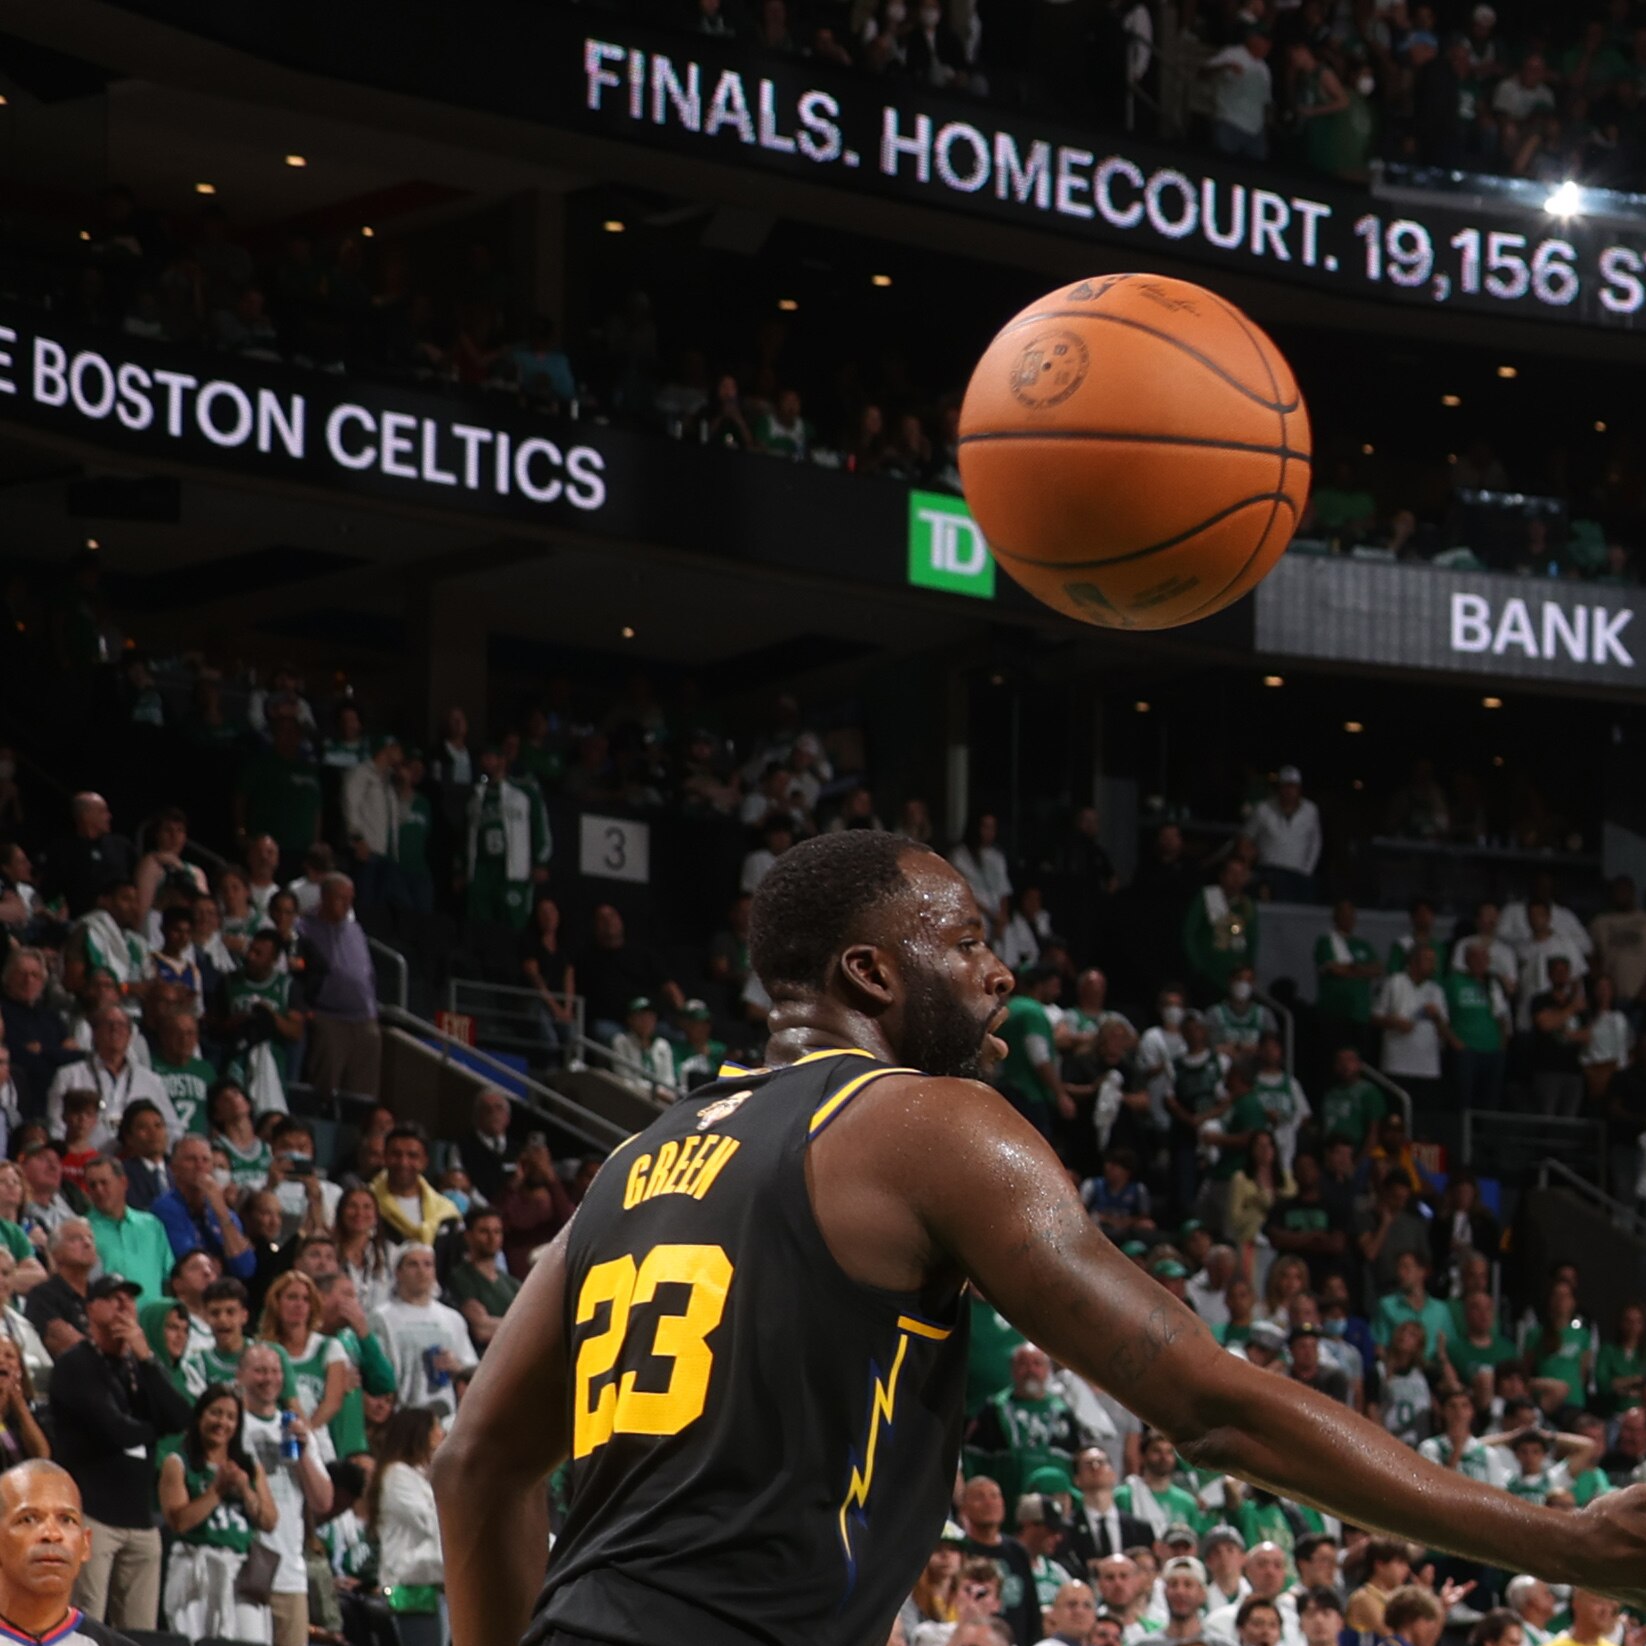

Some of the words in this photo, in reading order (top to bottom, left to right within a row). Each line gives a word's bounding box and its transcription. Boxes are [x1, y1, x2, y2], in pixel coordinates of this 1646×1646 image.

[585, 39, 860, 166] FINALS.
[881, 107, 1338, 271] HOMECOURT.
[1356, 212, 1578, 303] 19,156
[33, 337, 305, 459] BOSTON
[326, 403, 606, 511] CELTICS
[917, 507, 987, 576] TD
[1450, 594, 1635, 668] BANK
[604, 826, 626, 871] 3
[623, 1133, 741, 1210] GREEN
[573, 1244, 734, 1460] 23
